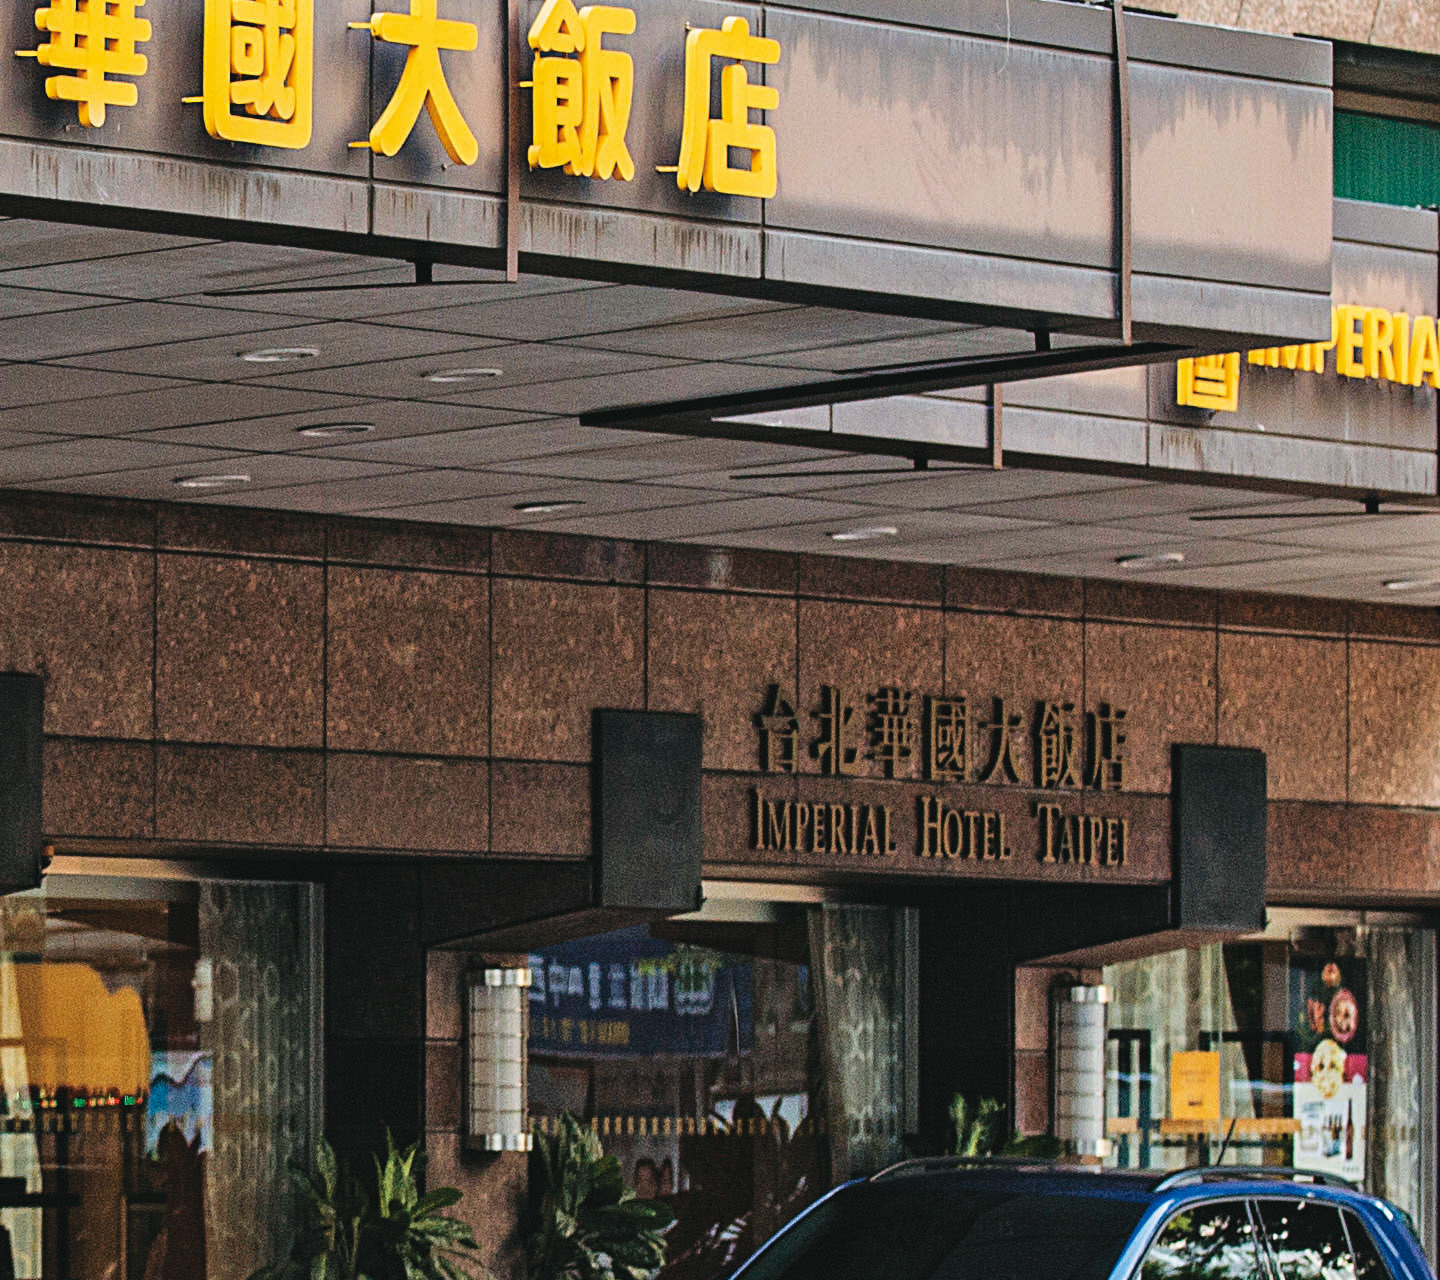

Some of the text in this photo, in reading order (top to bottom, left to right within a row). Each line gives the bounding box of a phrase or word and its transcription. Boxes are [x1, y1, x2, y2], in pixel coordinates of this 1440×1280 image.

[756, 684, 1127, 791] 台北華國大飯店
[753, 789, 1129, 867] IMPERIAL HOTEL TAIPEI
